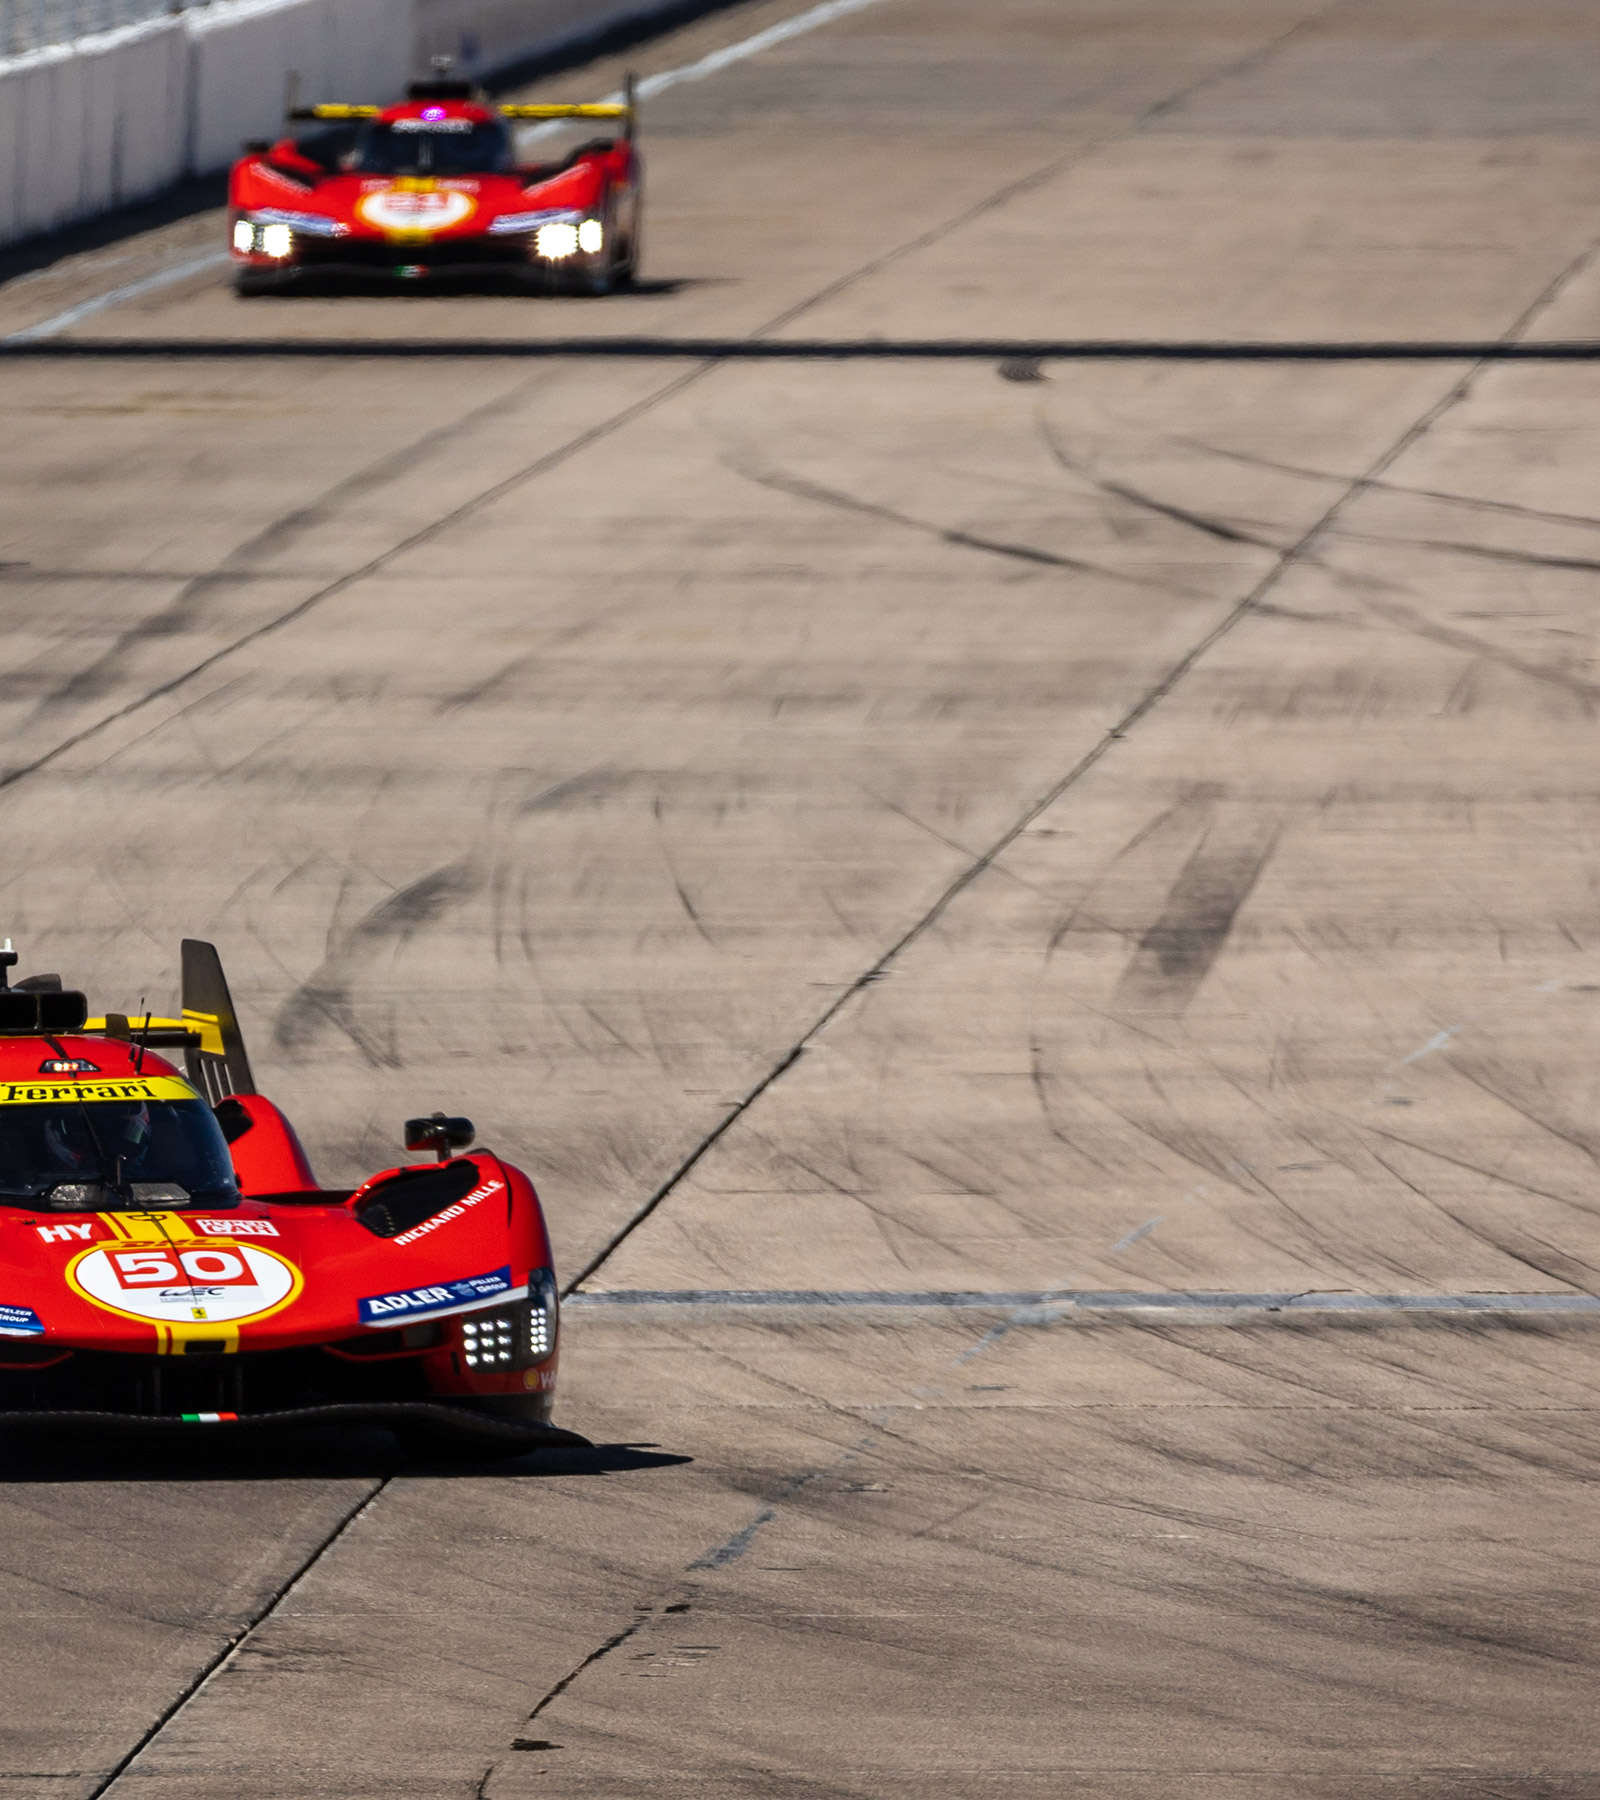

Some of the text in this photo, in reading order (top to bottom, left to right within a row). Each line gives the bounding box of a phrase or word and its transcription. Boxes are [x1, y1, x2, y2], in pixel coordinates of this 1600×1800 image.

[2, 1080, 156, 1101] Ferrari
[394, 1179, 505, 1245] RICHARD MILLE
[37, 1223, 92, 1243] HY
[207, 1225, 274, 1234] CAR
[115, 1251, 244, 1283] 50
[468, 1276, 502, 1286] PELZER
[475, 1282, 509, 1293] GROUP
[159, 1287, 225, 1297] WEC
[368, 1287, 455, 1314] ADLER
